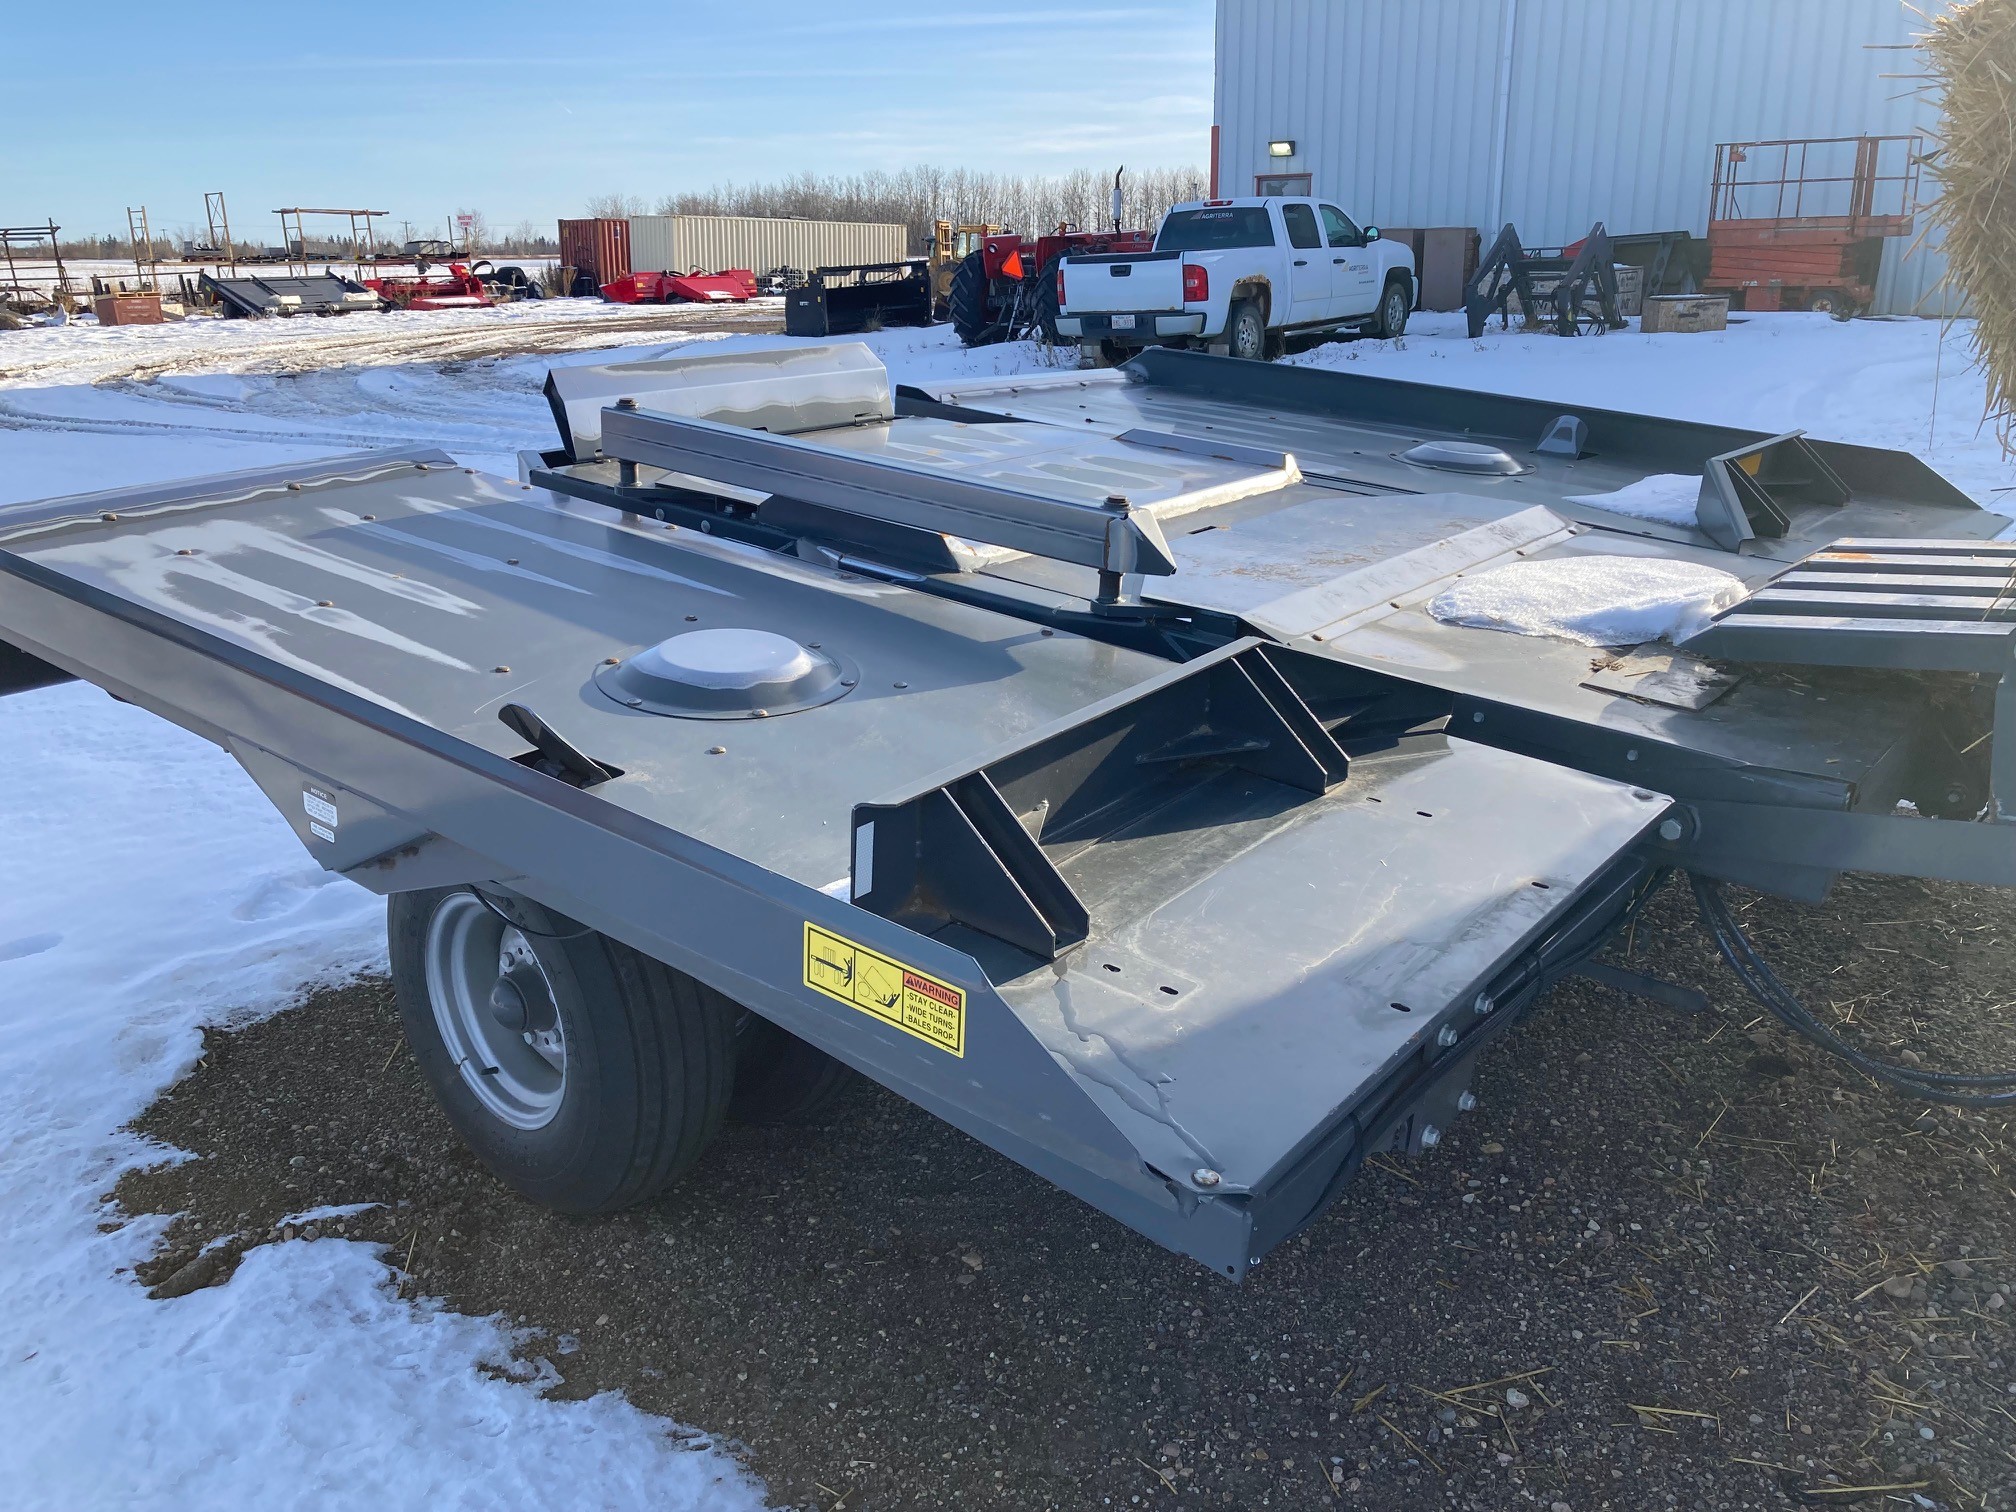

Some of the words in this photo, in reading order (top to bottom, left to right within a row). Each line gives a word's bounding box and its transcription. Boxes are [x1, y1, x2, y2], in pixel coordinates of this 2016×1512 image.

[1201, 212, 1234, 220] AGRITERRA
[310, 787, 328, 800] NOTICE
[914, 979, 959, 1006] WARNING
